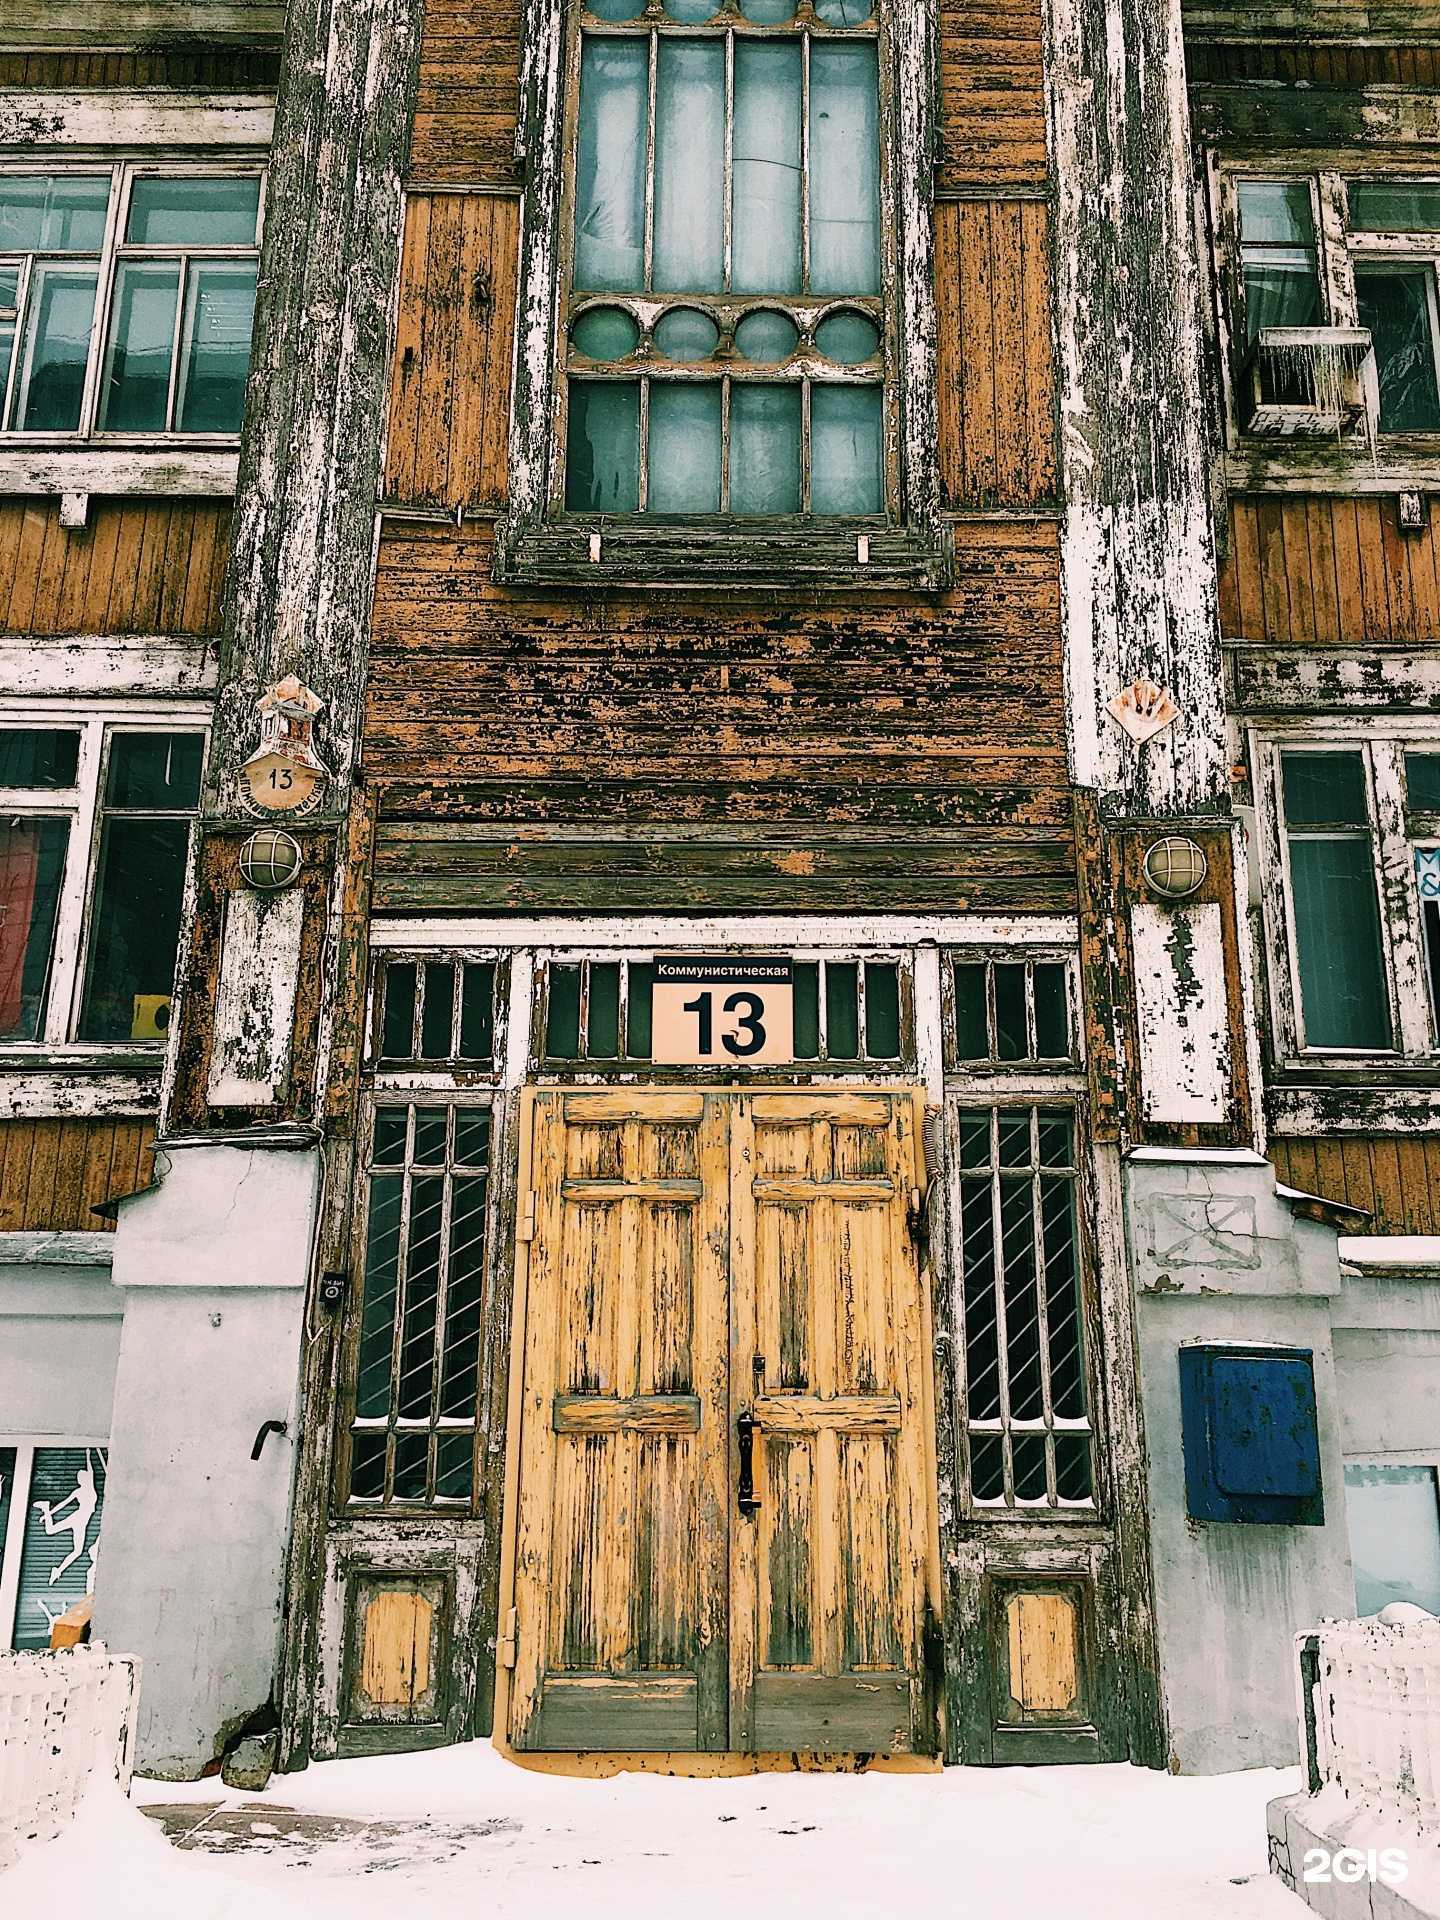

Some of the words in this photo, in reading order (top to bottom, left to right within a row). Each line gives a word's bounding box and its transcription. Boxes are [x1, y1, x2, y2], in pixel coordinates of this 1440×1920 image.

[269, 768, 293, 790] 13
[657, 963, 789, 978] Коммунистическая
[683, 991, 767, 1057] 13
